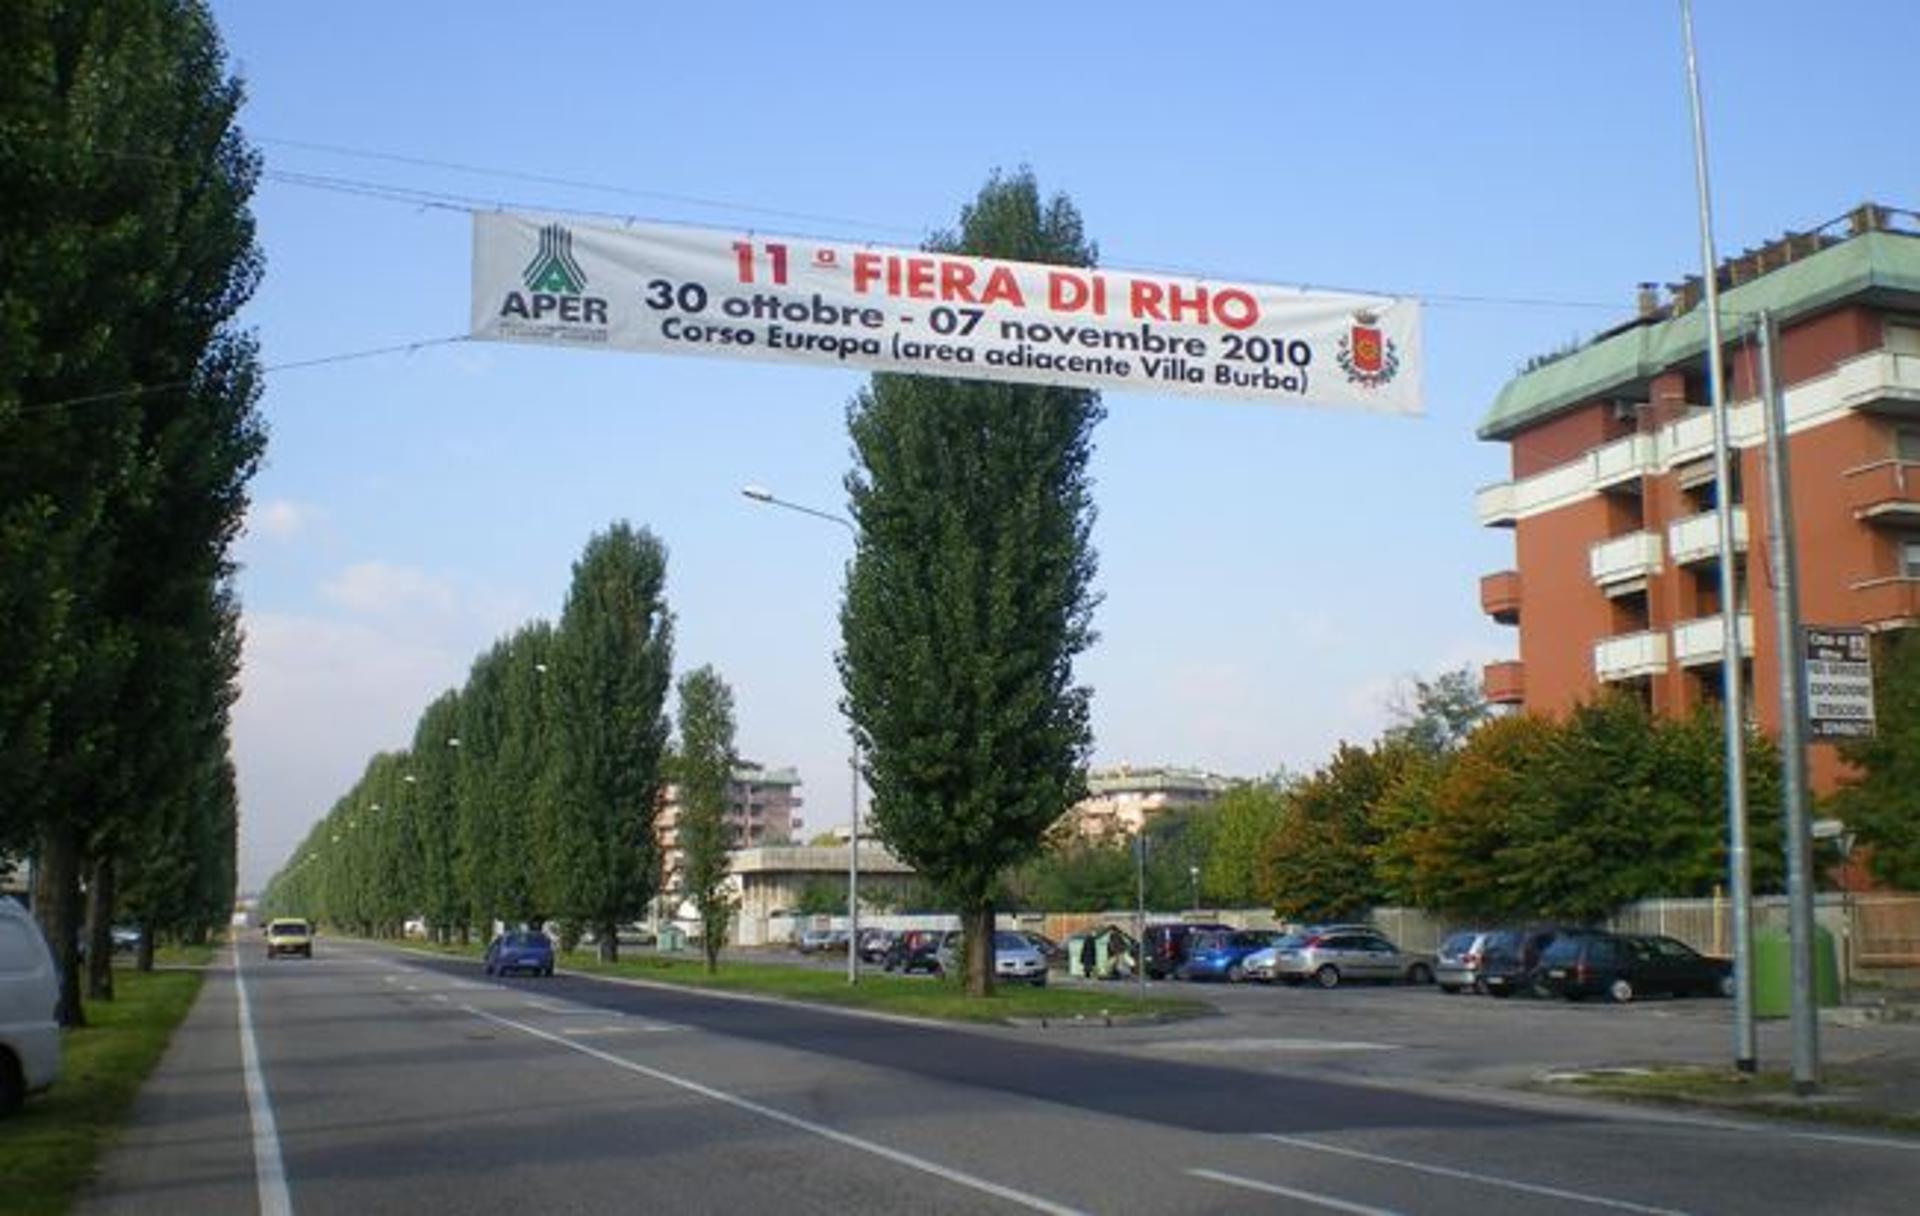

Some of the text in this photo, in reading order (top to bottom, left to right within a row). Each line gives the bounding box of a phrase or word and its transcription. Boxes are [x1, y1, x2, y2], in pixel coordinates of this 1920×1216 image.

[501, 291, 608, 325] APER
[646, 279, 708, 313] 30
[722, 294, 884, 329] ottobre
[929, 306, 985, 336] 07
[1000, 323, 1207, 358] novembre
[1221, 334, 1312, 368] 2010
[853, 253, 1025, 308] FIERA
[1048, 271, 1106, 316] DI
[1130, 279, 1260, 330] RHO
[661, 317, 1308, 395] Corso Europa (area adiacente Villa Burba)
